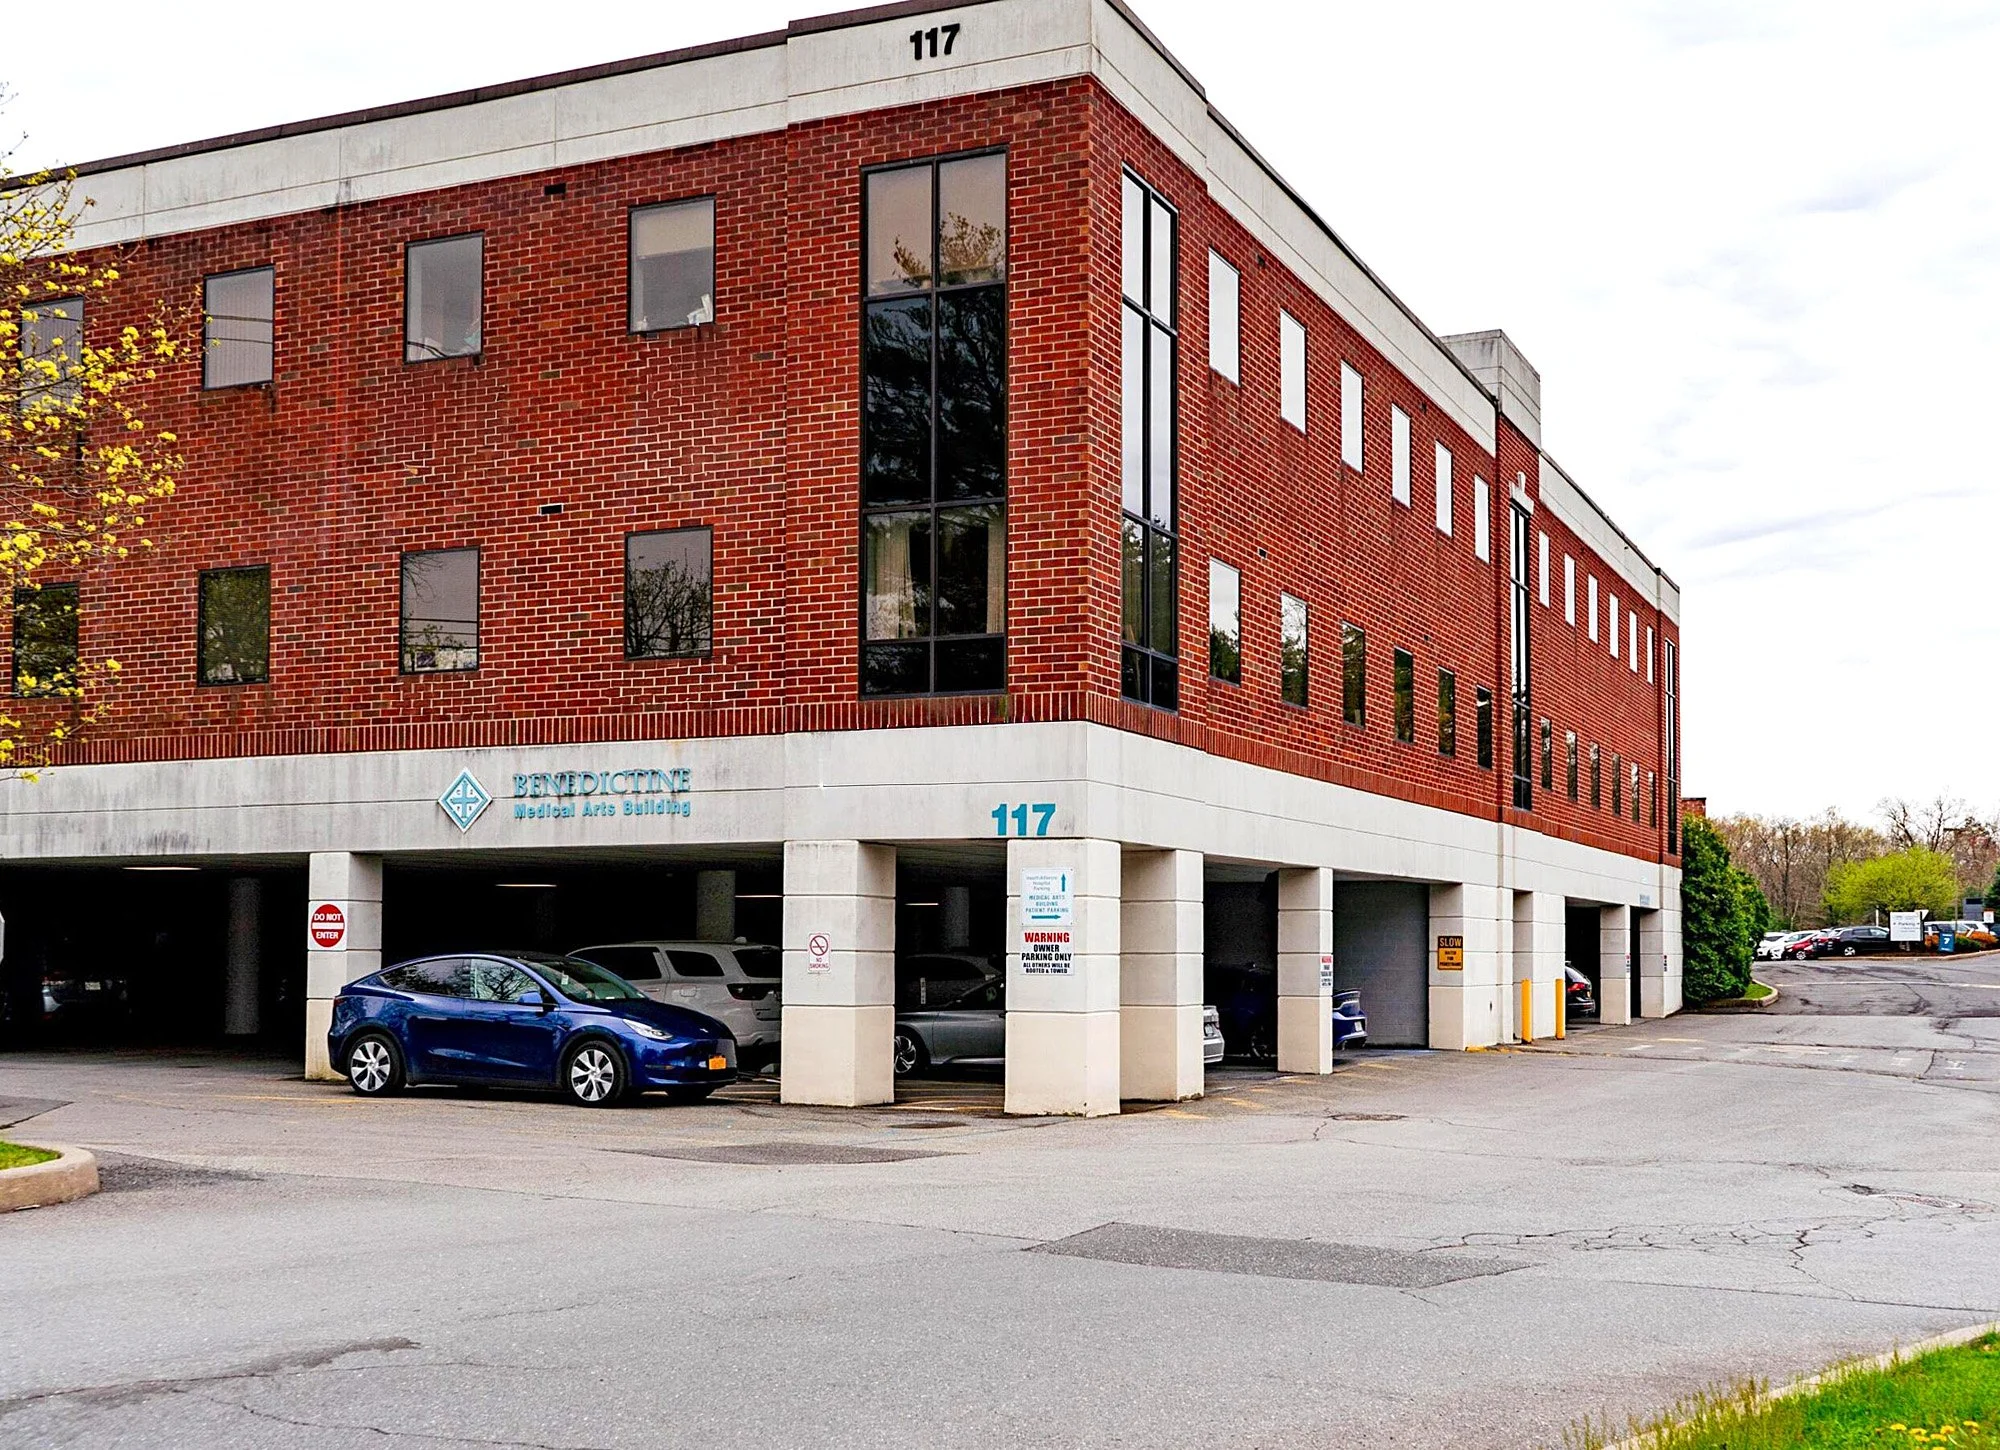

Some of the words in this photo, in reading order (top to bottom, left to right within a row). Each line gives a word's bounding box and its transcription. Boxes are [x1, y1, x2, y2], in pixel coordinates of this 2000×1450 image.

[910, 23, 960, 60] 117
[513, 768, 691, 798] BENEDICTINE
[514, 803, 575, 819] Medical
[582, 801, 616, 816] Arts
[623, 799, 691, 817] Building
[991, 803, 1056, 836] 117
[314, 913, 325, 921] DO
[326, 913, 342, 921] NOT
[316, 931, 339, 940] ENTER
[1024, 932, 1070, 942] WARNING
[1440, 937, 1462, 947] SLOW
[1033, 944, 1060, 952] OWNER
[1021, 952, 1053, 961] PARKING
[1054, 952, 1072, 961] ONLY
